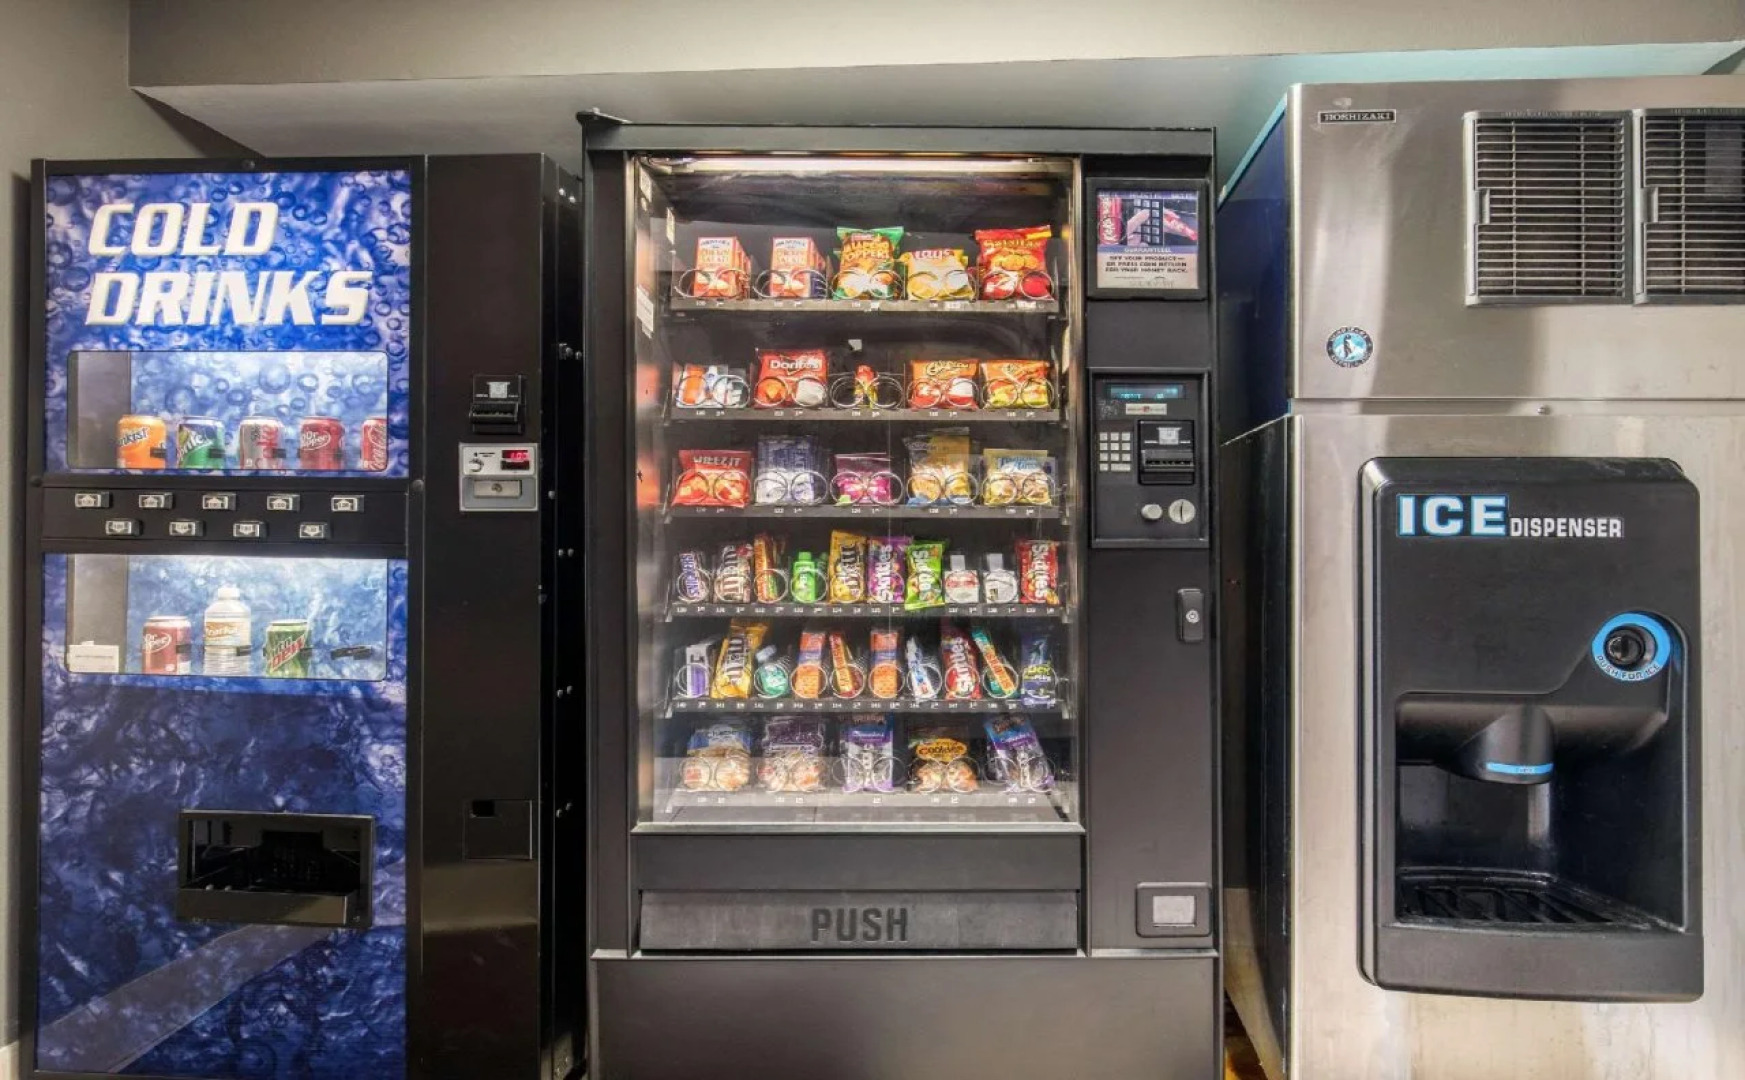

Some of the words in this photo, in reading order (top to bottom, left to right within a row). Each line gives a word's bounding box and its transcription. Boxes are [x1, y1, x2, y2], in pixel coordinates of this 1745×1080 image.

[88, 202, 279, 256] COLD
[85, 270, 373, 326] DRINKS
[1398, 495, 1508, 536] ICE
[1509, 517, 1622, 538] DISPENSER
[1621, 671, 1644, 680] FOR
[811, 907, 908, 942] PUSH
